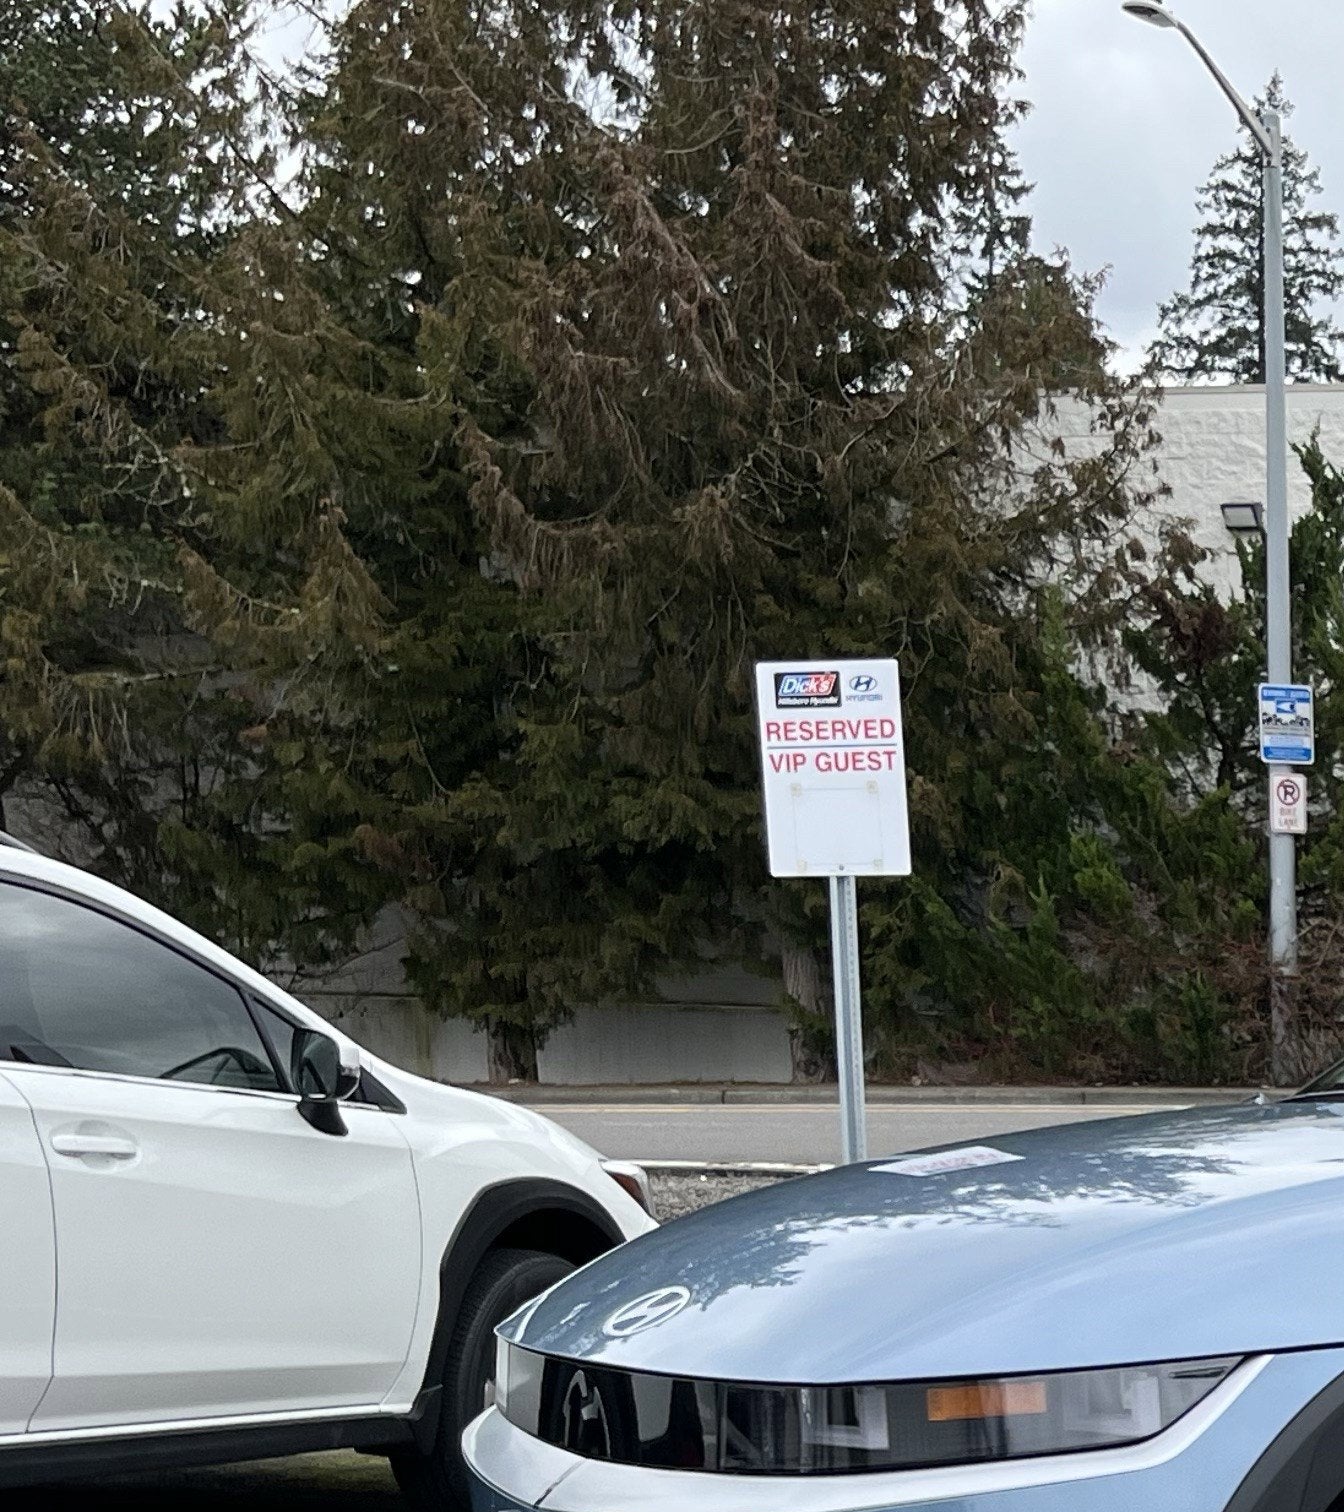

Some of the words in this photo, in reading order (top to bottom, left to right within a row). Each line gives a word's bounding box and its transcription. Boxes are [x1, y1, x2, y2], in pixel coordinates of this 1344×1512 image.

[766, 719, 896, 742] RESERVED
[769, 752, 807, 773] VIP
[815, 751, 897, 772] GUEST
